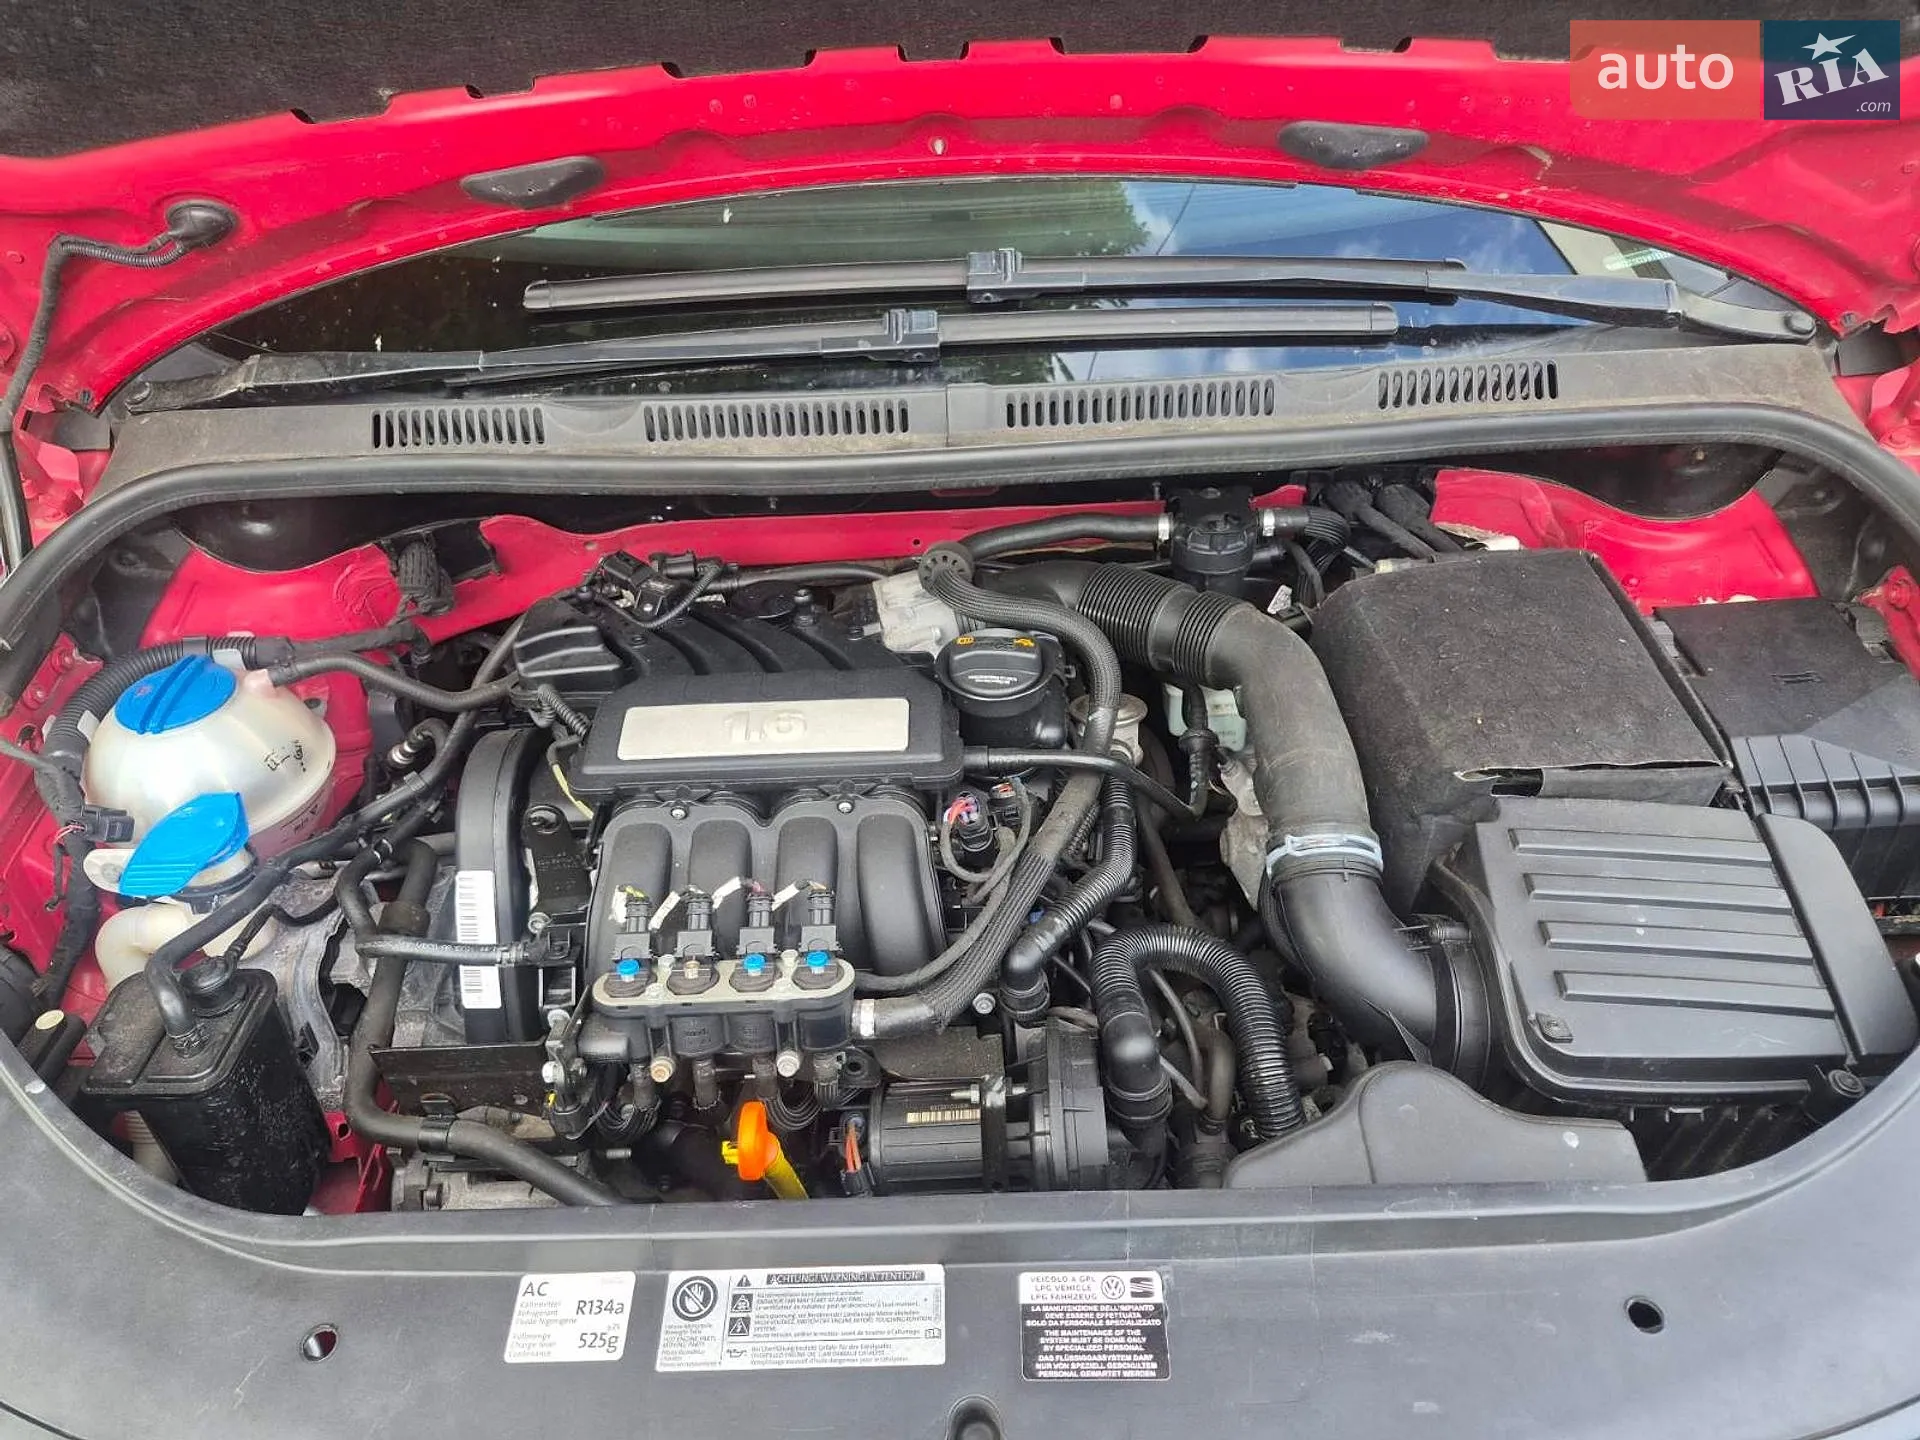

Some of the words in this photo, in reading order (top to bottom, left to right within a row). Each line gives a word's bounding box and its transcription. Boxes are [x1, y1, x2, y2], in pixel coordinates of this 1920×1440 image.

[723, 709, 808, 742] 1.6
[522, 1281, 550, 1296] AC
[576, 1299, 624, 1316] R134a
[578, 1332, 620, 1354] 525g
